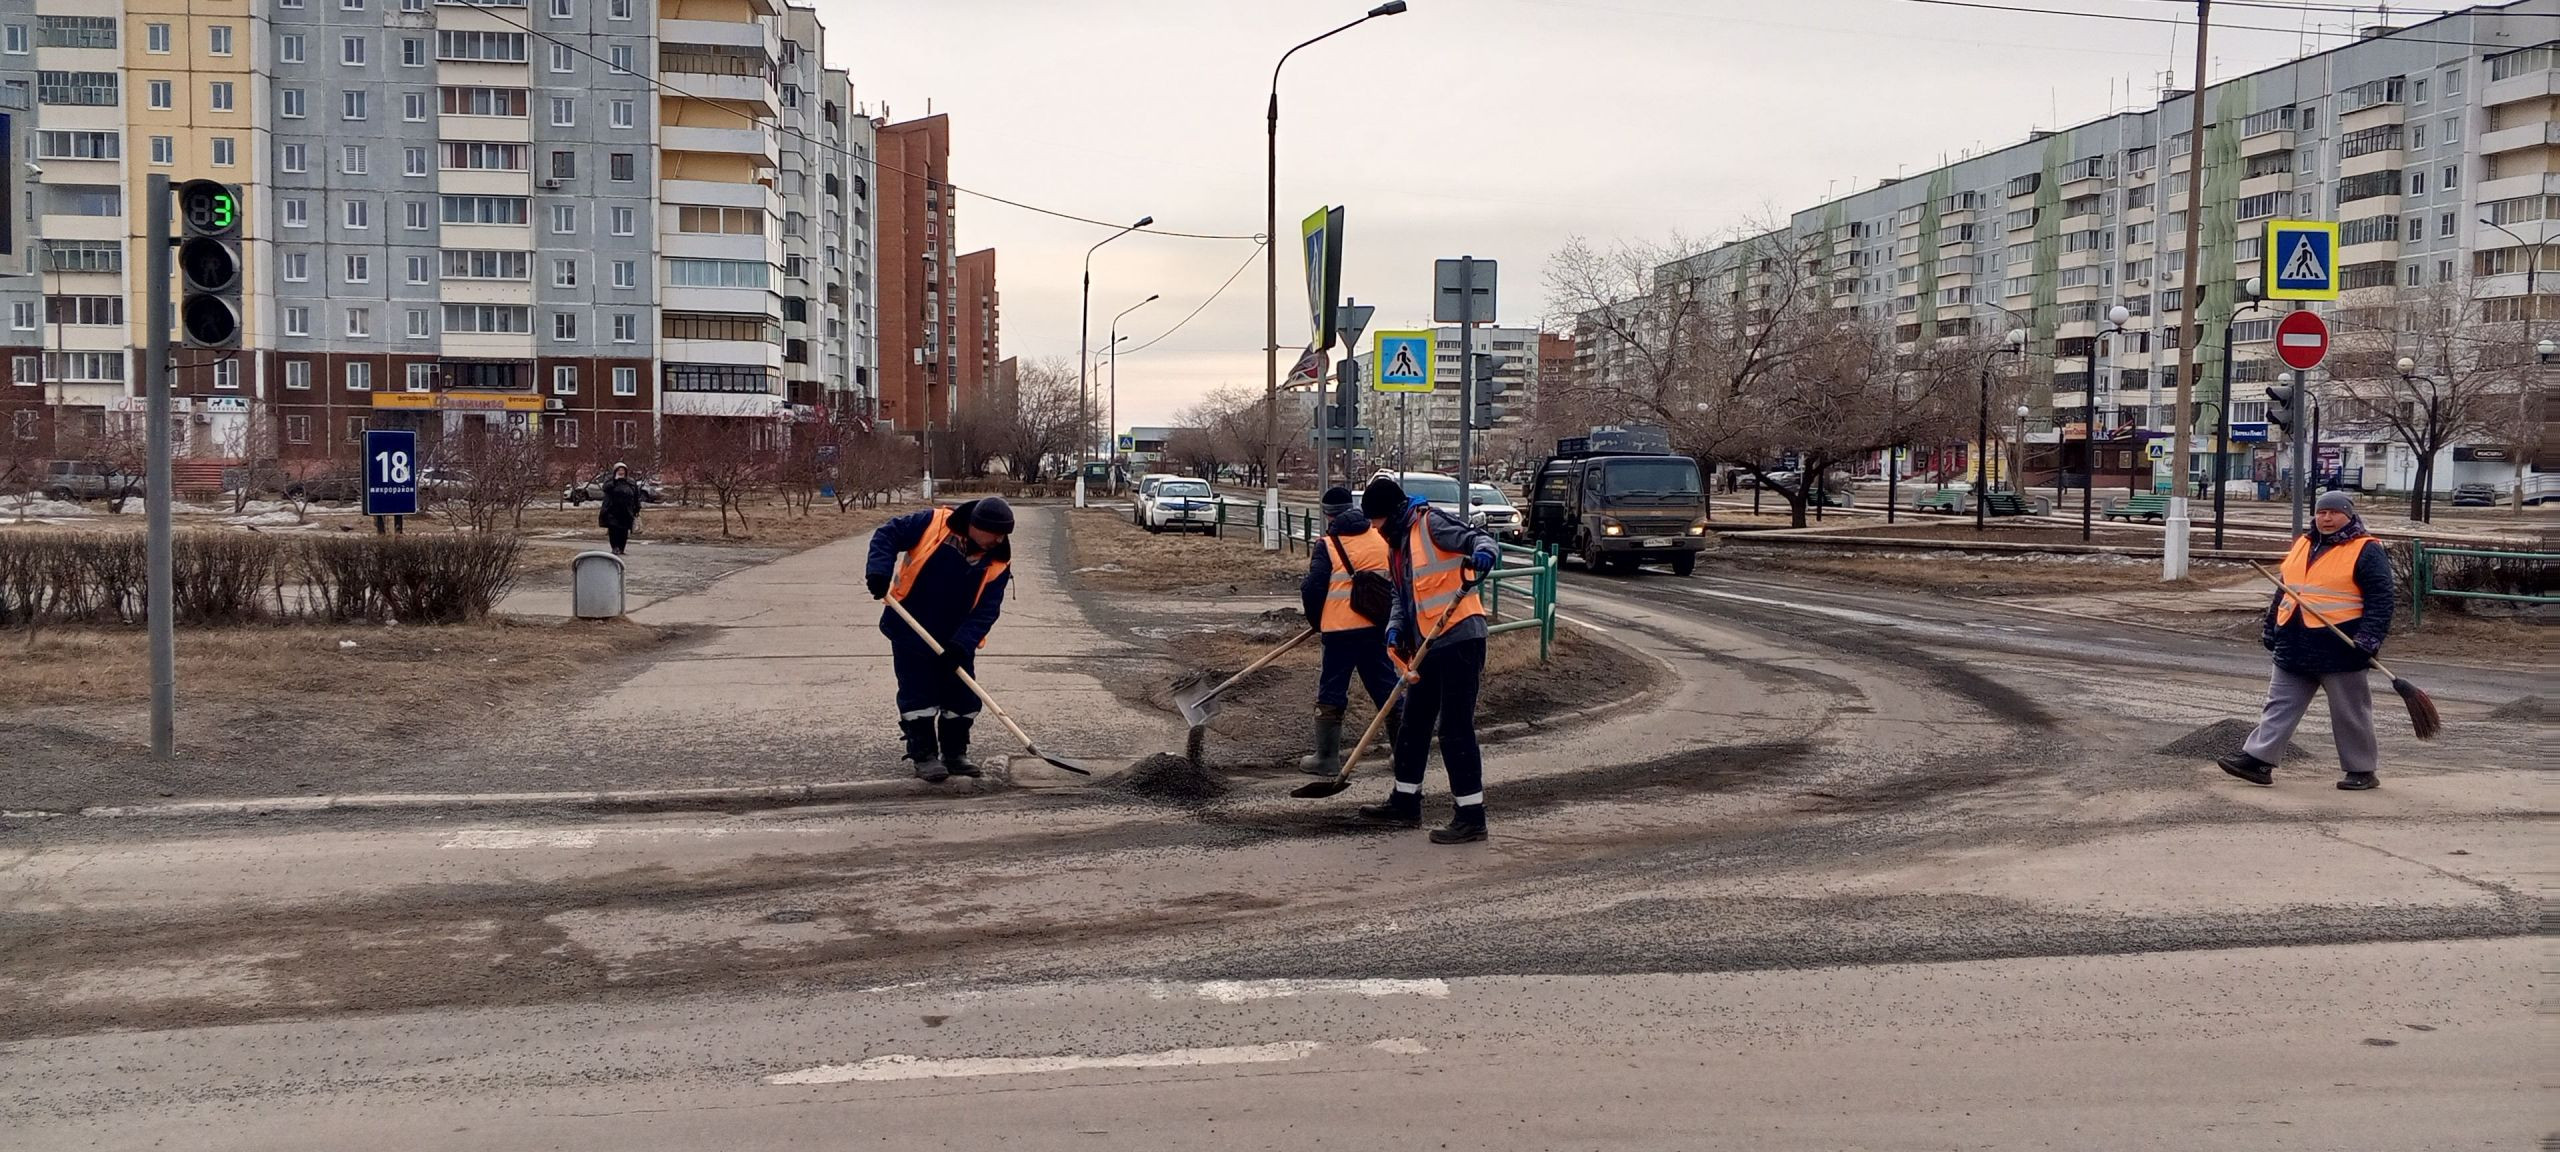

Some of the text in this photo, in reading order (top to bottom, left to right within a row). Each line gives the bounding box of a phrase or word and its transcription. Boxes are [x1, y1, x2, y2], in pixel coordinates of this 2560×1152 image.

[214, 195, 231, 226] 3
[376, 451, 409, 484] 18
[370, 485, 414, 495] микрорайон
